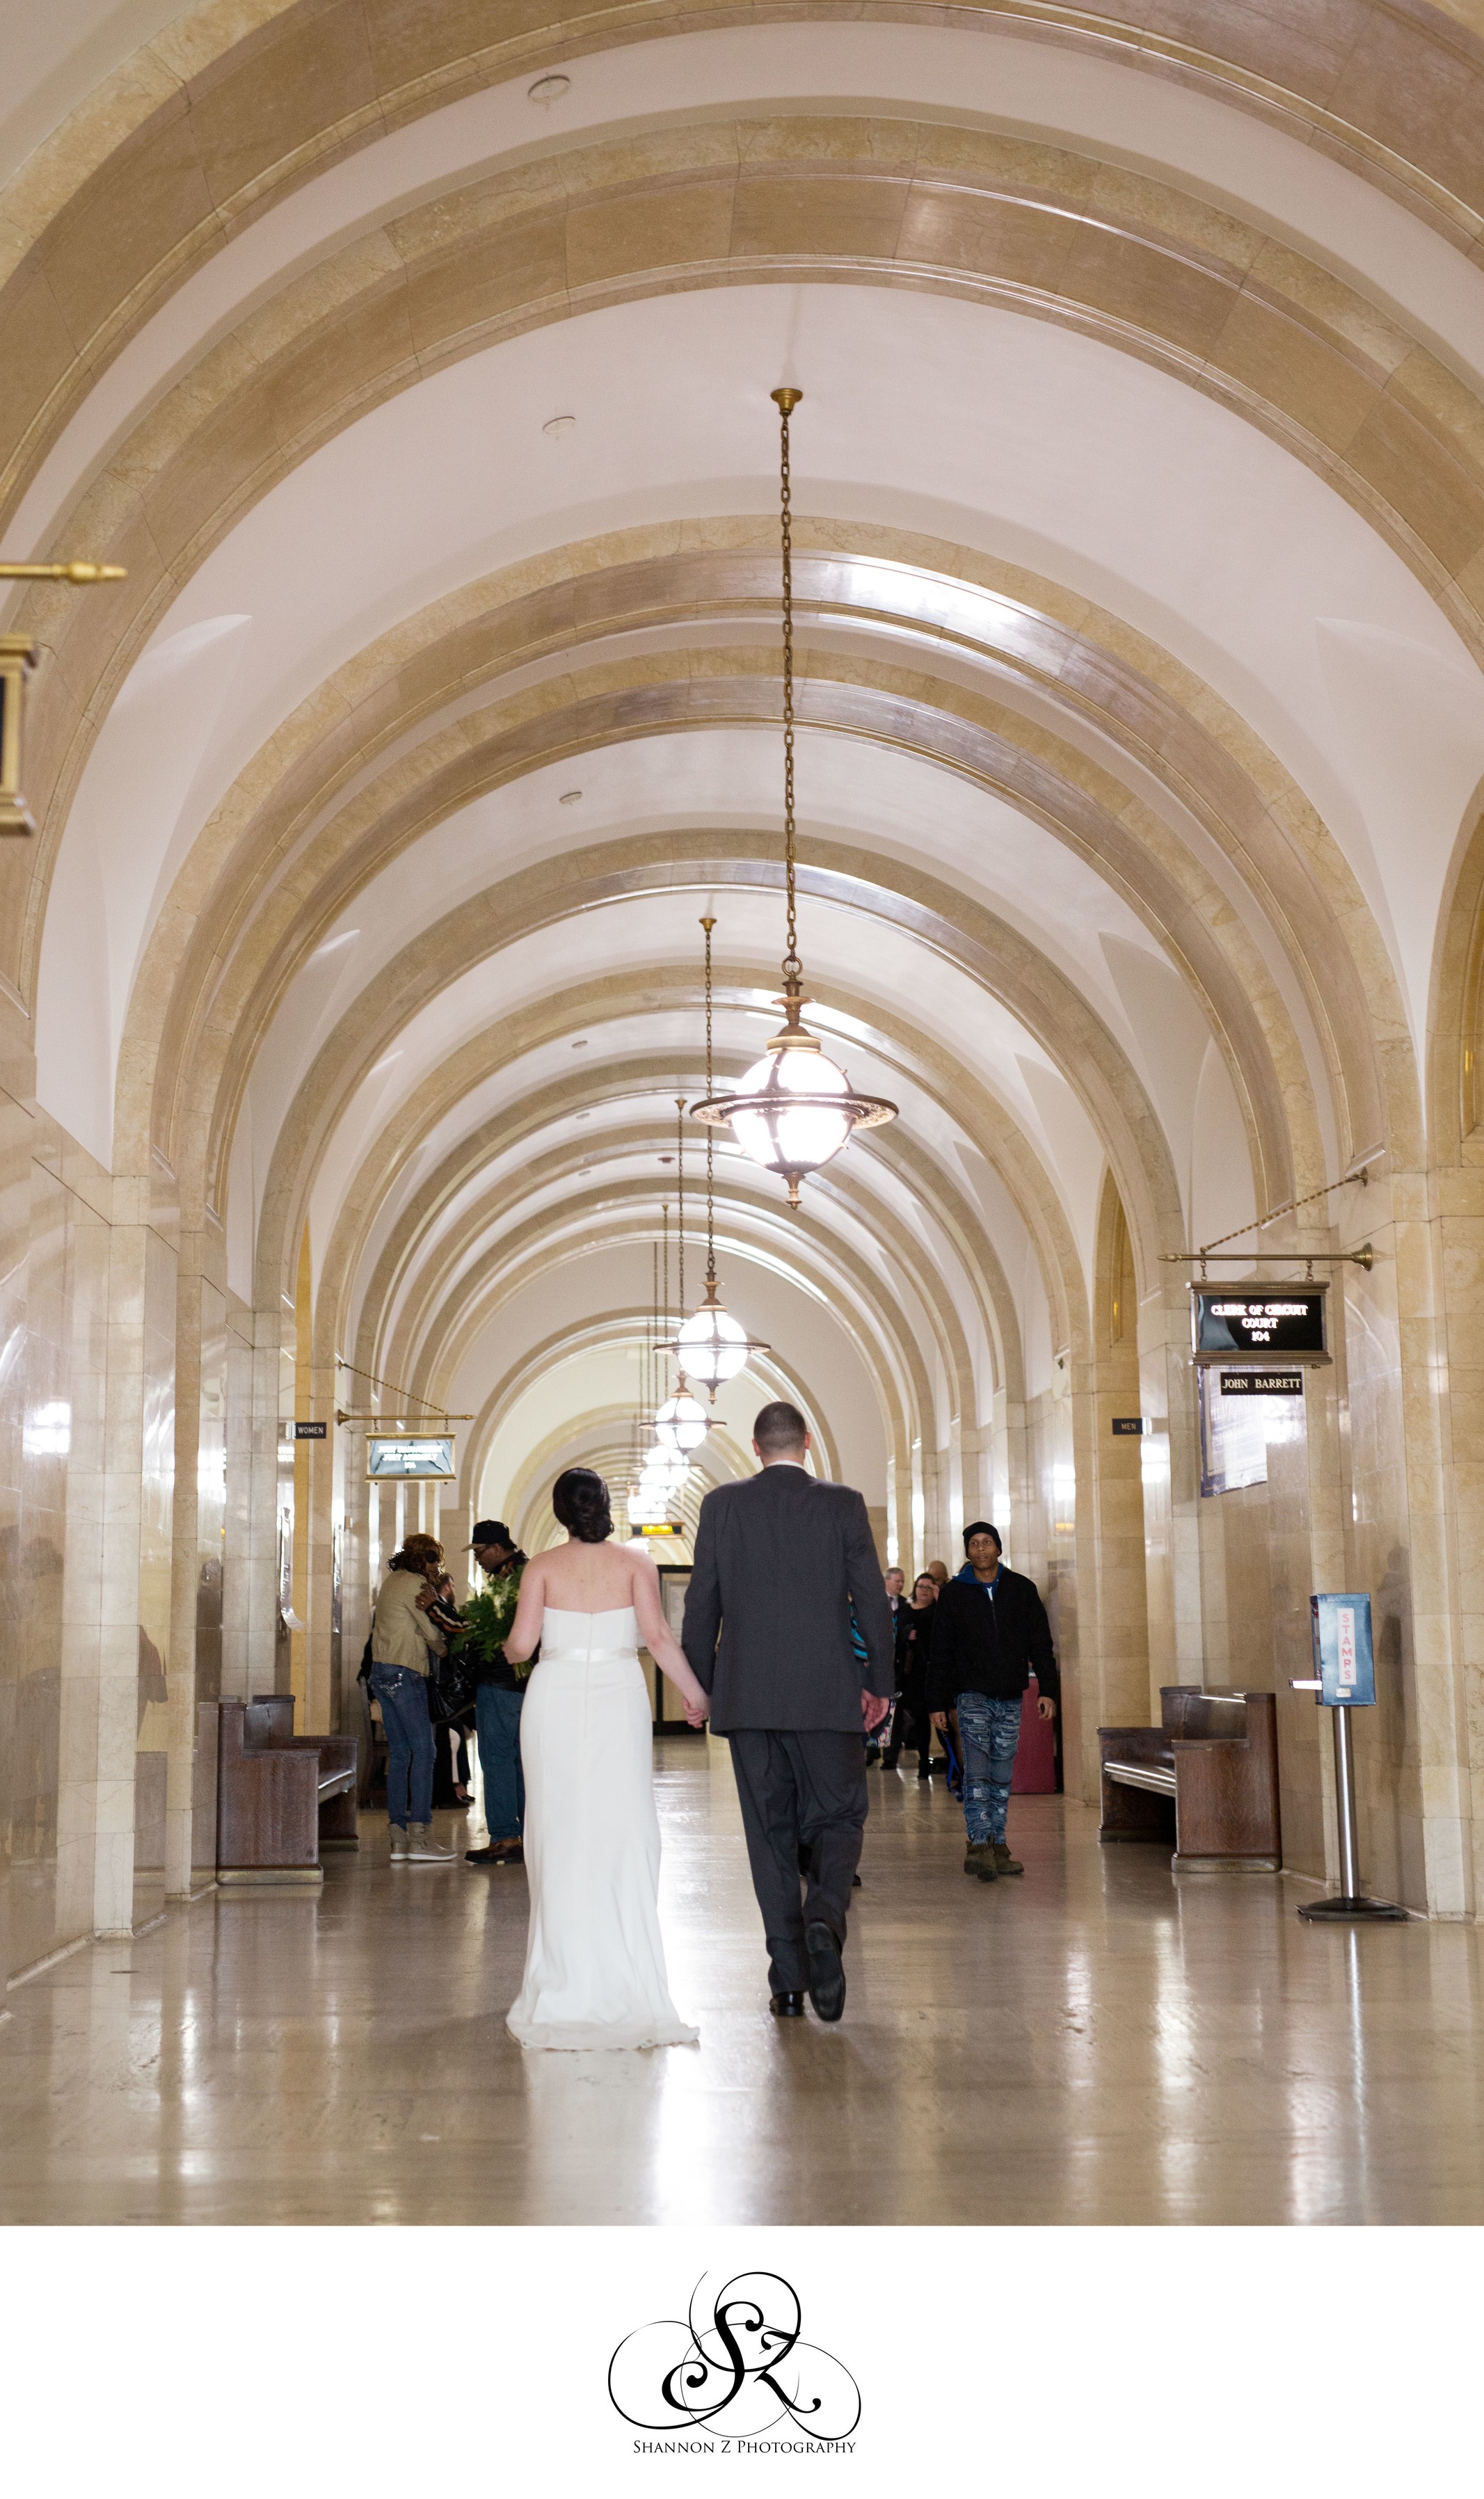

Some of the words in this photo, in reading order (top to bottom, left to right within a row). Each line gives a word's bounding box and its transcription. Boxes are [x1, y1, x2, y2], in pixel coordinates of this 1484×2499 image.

[1211, 1304, 1247, 1316] CLERK
[1249, 1304, 1264, 1316] OF
[1265, 1304, 1308, 1316] CIRCUIT
[1241, 1318, 1279, 1329] COURT
[1251, 1331, 1270, 1341] 104
[1222, 1379, 1248, 1389] JOHN
[1254, 1378, 1302, 1389] BARRETT
[297, 1426, 324, 1435] WOMEN
[1341, 1613, 1353, 1679] STAMPS
